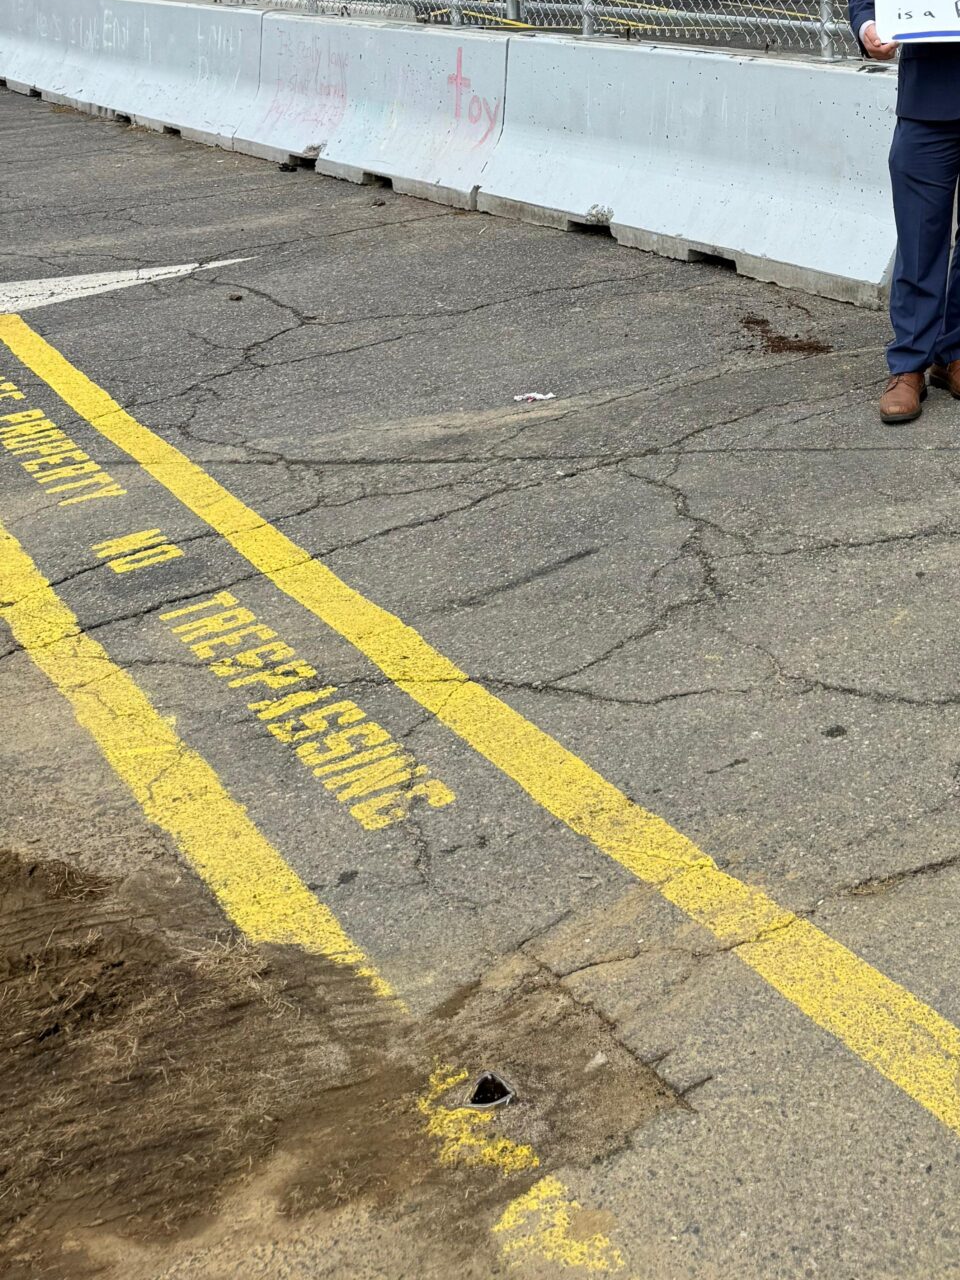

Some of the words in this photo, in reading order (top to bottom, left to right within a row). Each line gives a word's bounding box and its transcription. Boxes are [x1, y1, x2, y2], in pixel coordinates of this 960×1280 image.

[897, 7, 913, 20] is
[924, 10, 936, 19] a
[0, 408, 127, 506] PROPERTY
[91, 528, 185, 574] NO
